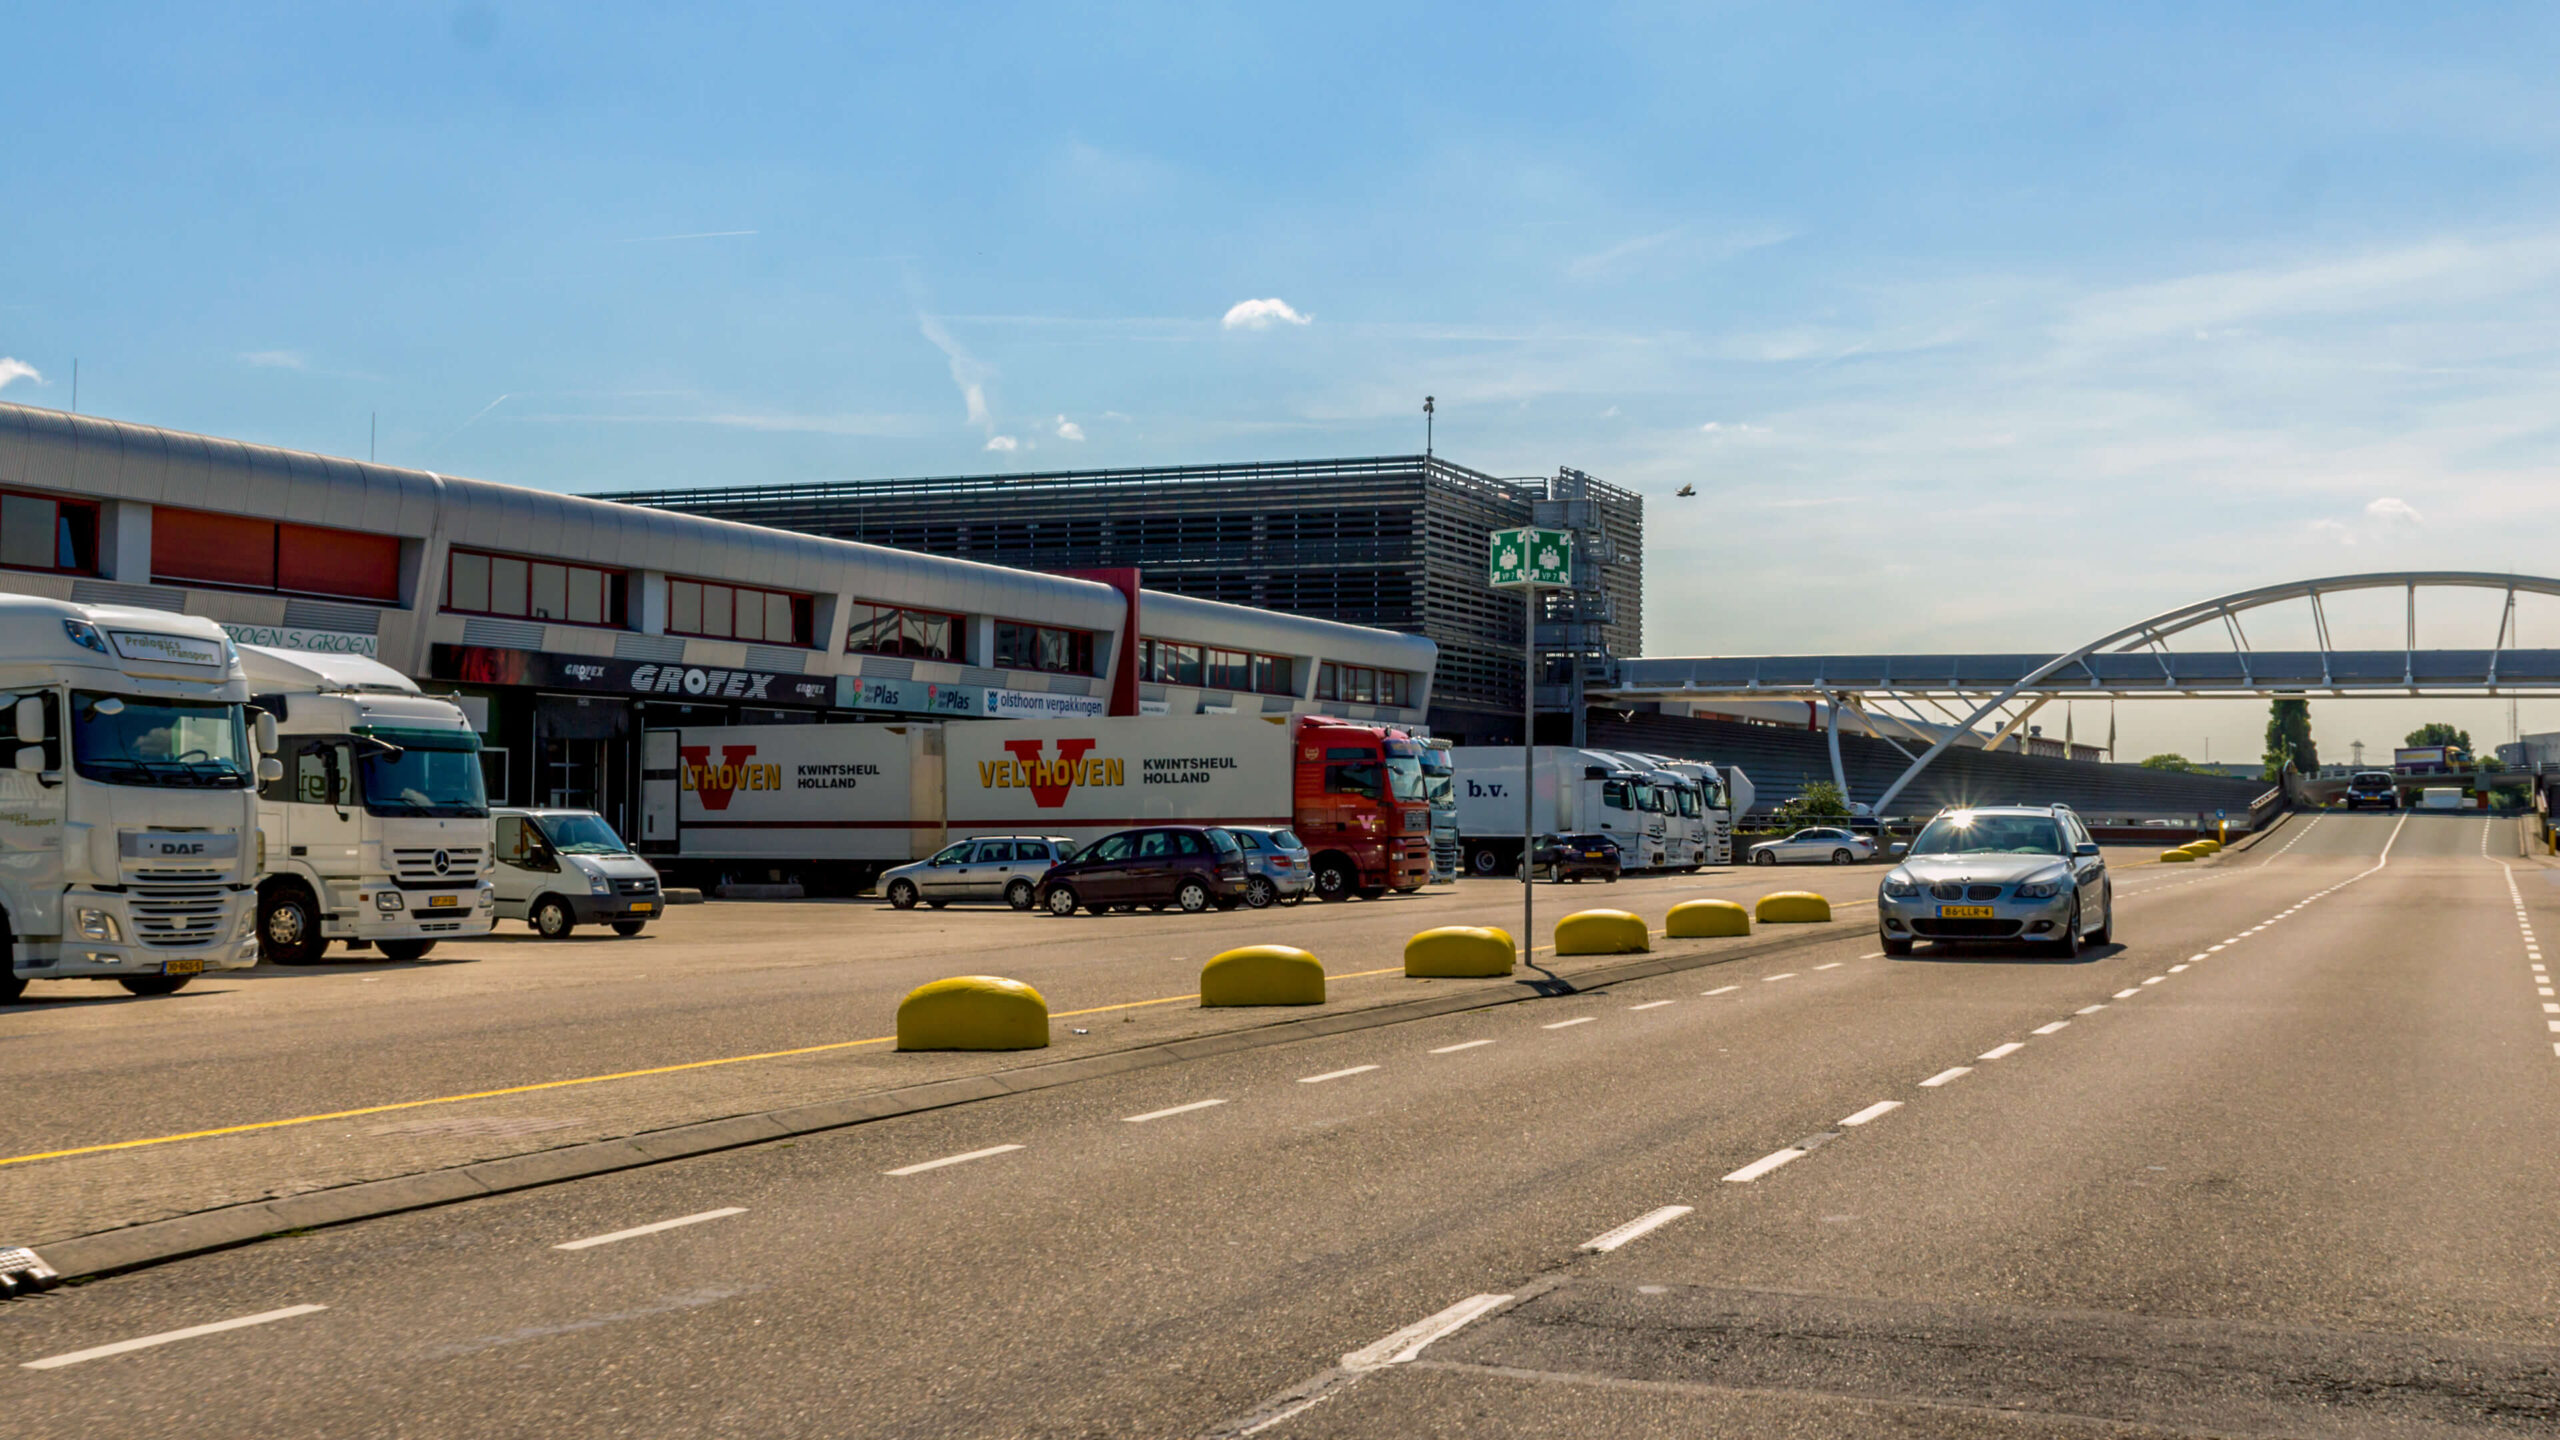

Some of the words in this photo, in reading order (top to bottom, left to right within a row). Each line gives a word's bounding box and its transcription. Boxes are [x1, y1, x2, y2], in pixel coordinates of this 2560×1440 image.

[1542, 571, 1552, 580] VP
[124, 635, 181, 652] Prologics
[221, 626, 283, 647] ROEN
[287, 632, 304, 648] S.
[307, 633, 377, 654] GROEN
[565, 664, 605, 677] GROTEX
[631, 664, 776, 700] GROTEX
[795, 683, 826, 695] GROTEX
[873, 684, 899, 705] Plas
[946, 691, 971, 710] Plas
[1001, 692, 1044, 709] olsthoorn
[1046, 696, 1103, 717] verpakkingen
[797, 764, 880, 776] KWINTSHEUL
[1143, 757, 1238, 771] KWINTSHEUL
[977, 758, 1125, 789] VELTHOVEN
[1143, 772, 1211, 785] HOLLAND
[797, 778, 857, 789] HOLLAND
[1467, 779, 1509, 798] b.v.
[161, 843, 205, 855] DAF
